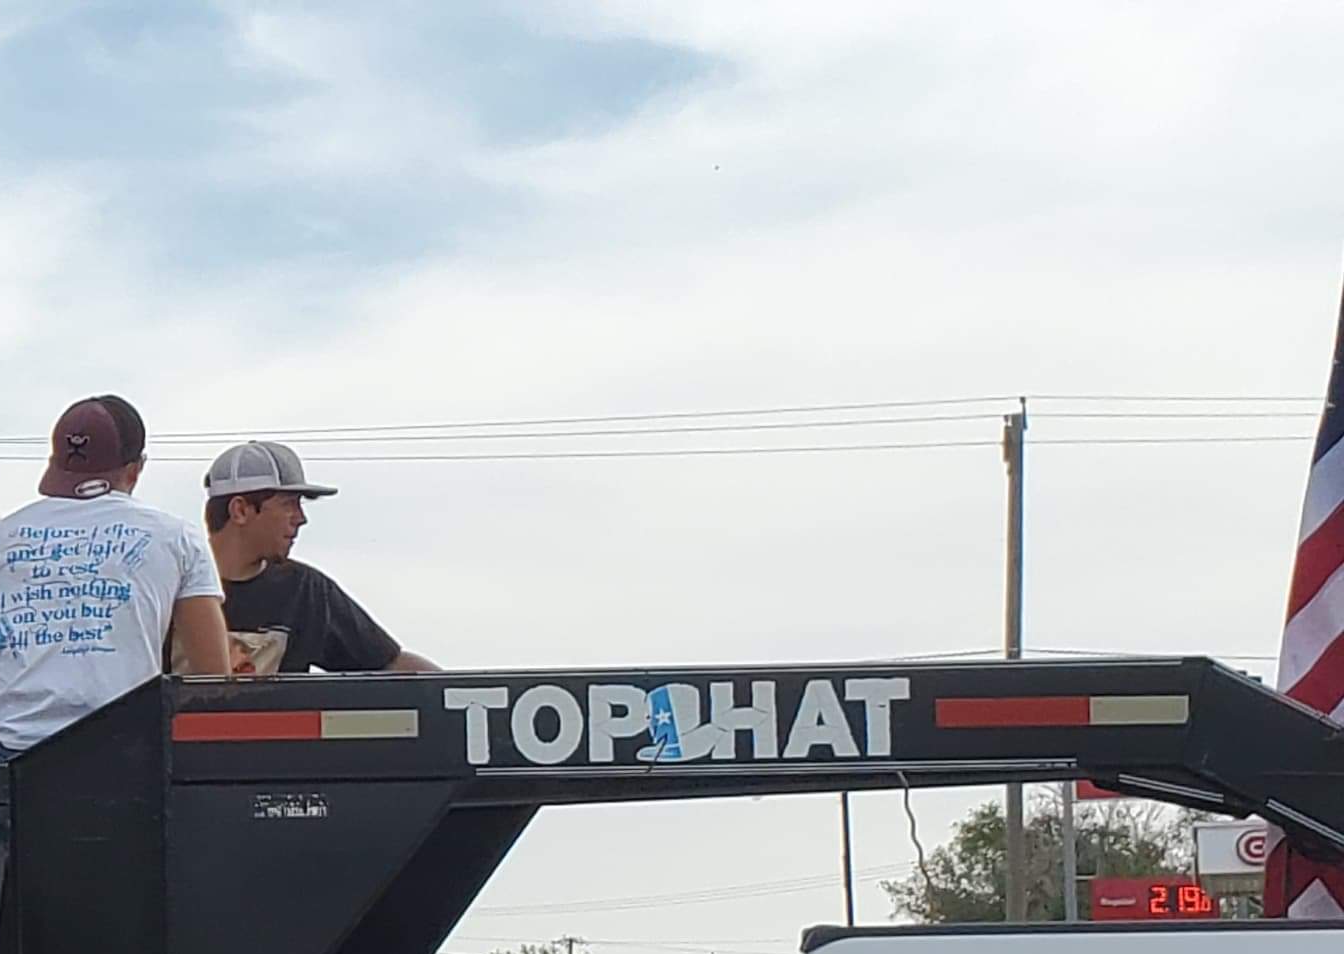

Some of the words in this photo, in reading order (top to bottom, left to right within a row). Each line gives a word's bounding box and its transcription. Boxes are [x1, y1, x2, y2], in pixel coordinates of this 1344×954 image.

[10, 526, 86, 543] Before
[31, 565, 52, 580] to
[11, 583, 53, 607] wish
[58, 579, 131, 601] nothing
[12, 611, 35, 625] on
[41, 605, 77, 622] you
[80, 602, 113, 619] but
[34, 629, 63, 646] the
[444, 684, 650, 764] TOP
[710, 677, 911, 760] HAT
